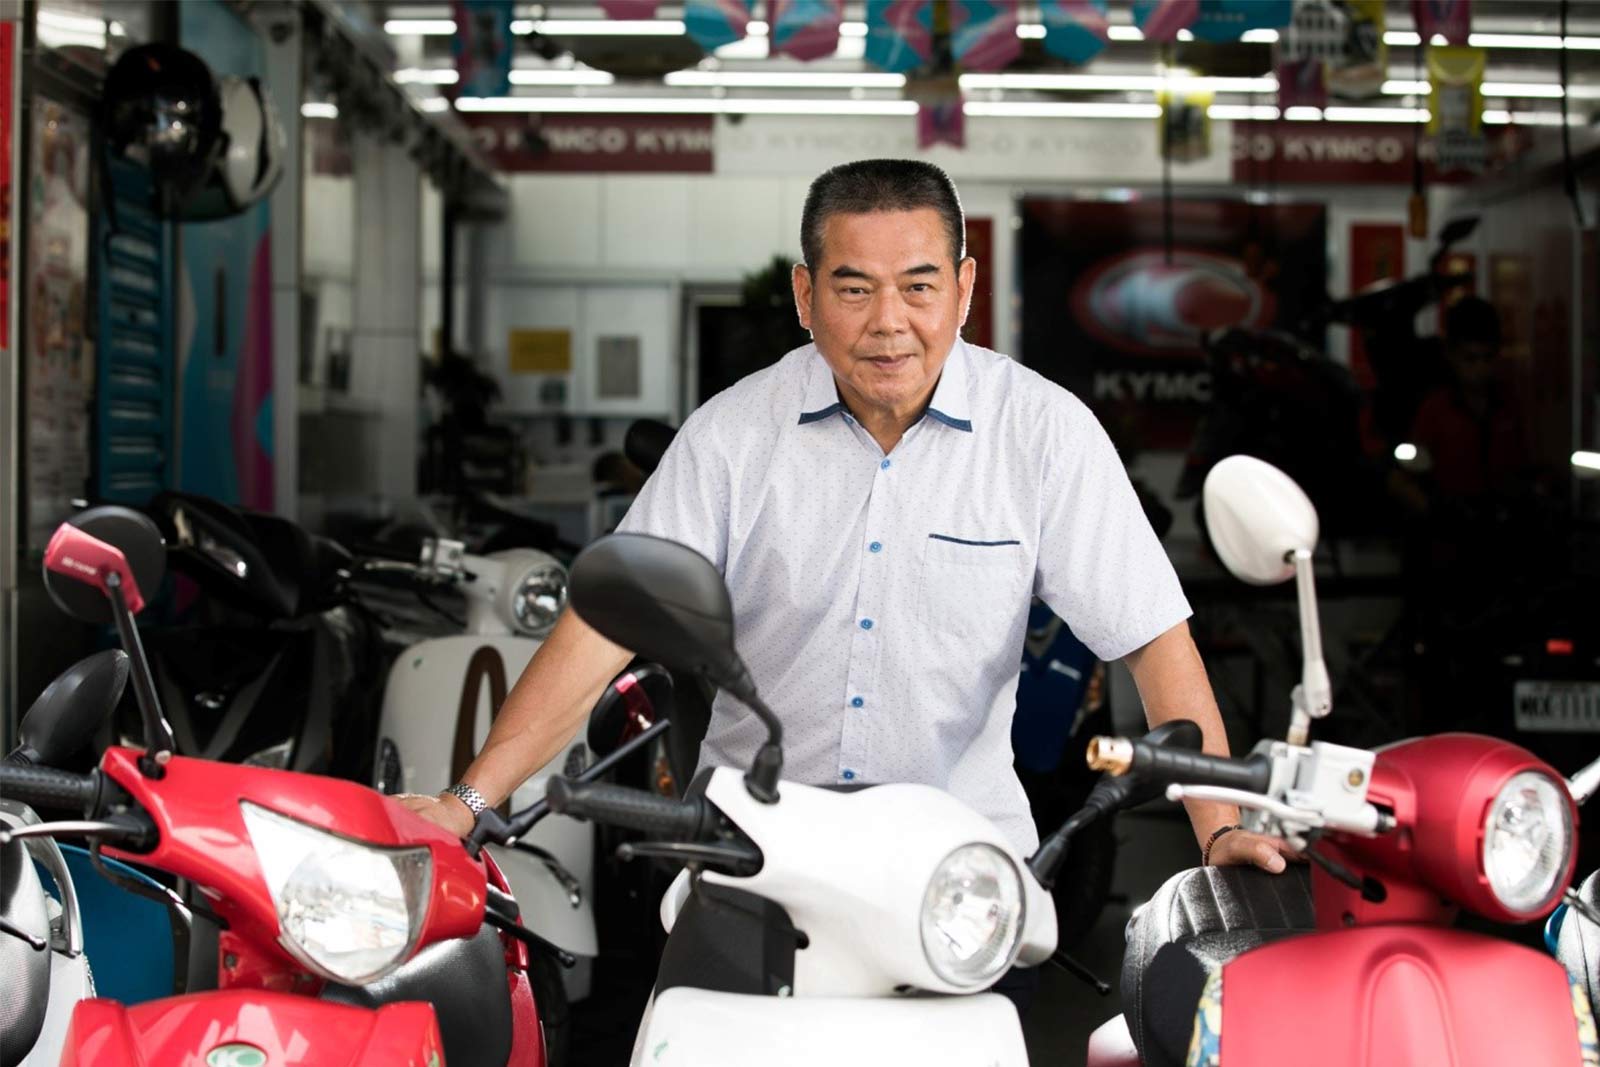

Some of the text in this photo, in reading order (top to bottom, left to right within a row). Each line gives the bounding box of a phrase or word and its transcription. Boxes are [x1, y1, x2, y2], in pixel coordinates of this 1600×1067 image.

[503, 126, 628, 153] KMCO
[1283, 136, 1403, 163] KYMCO
[1094, 371, 1213, 401] KYMC
